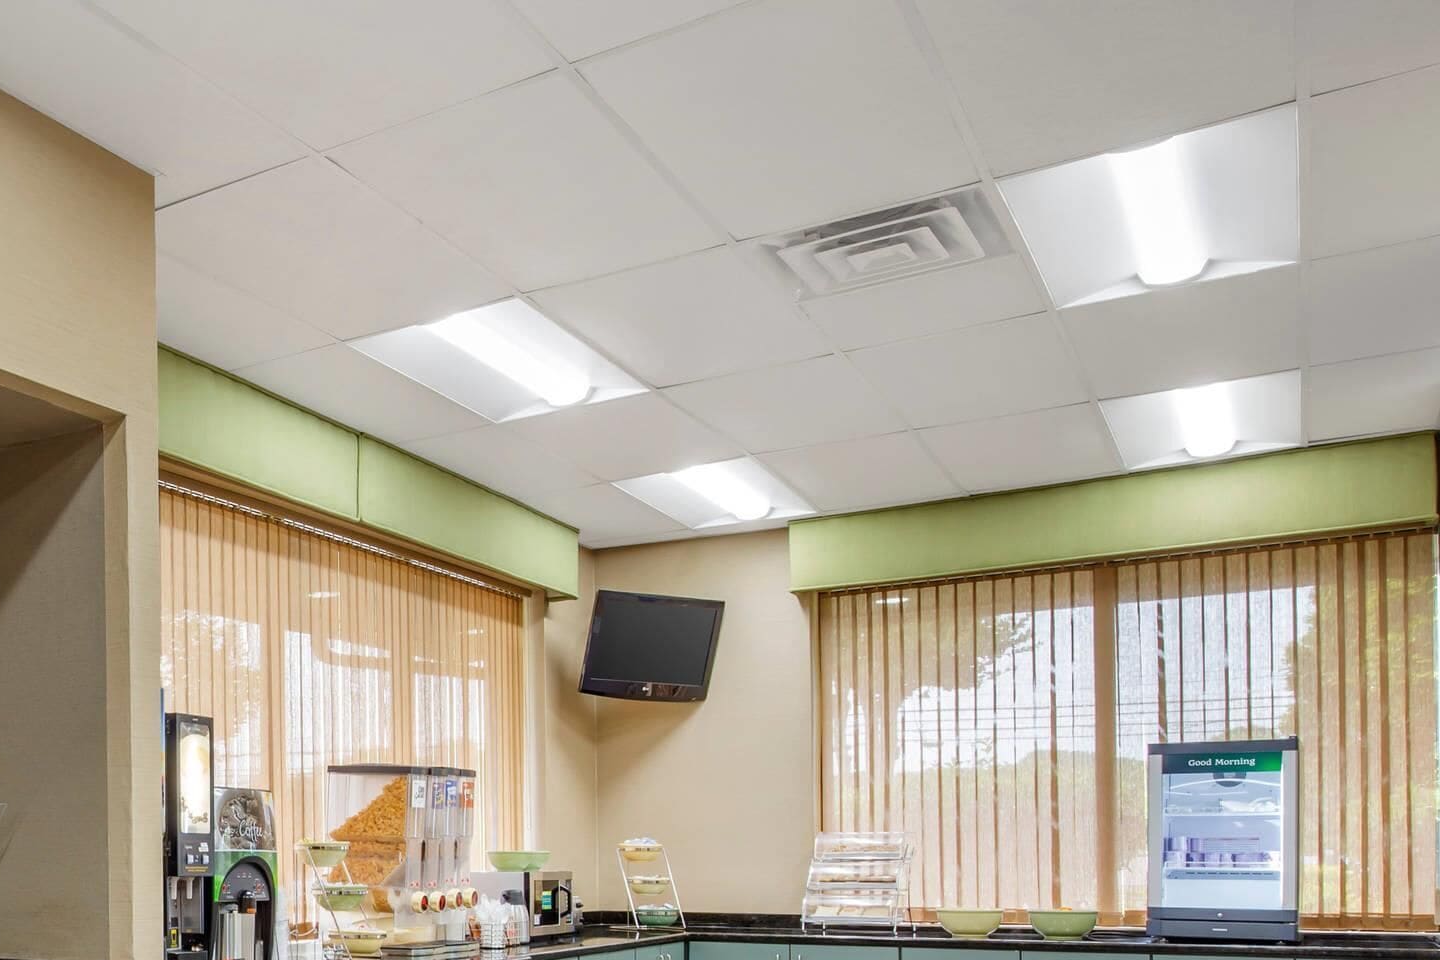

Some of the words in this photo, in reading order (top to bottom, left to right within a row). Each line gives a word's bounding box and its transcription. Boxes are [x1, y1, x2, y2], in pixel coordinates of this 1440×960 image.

[1187, 758, 1212, 767] Good
[1215, 757, 1256, 767] Morning
[239, 819, 264, 842] Coffee
